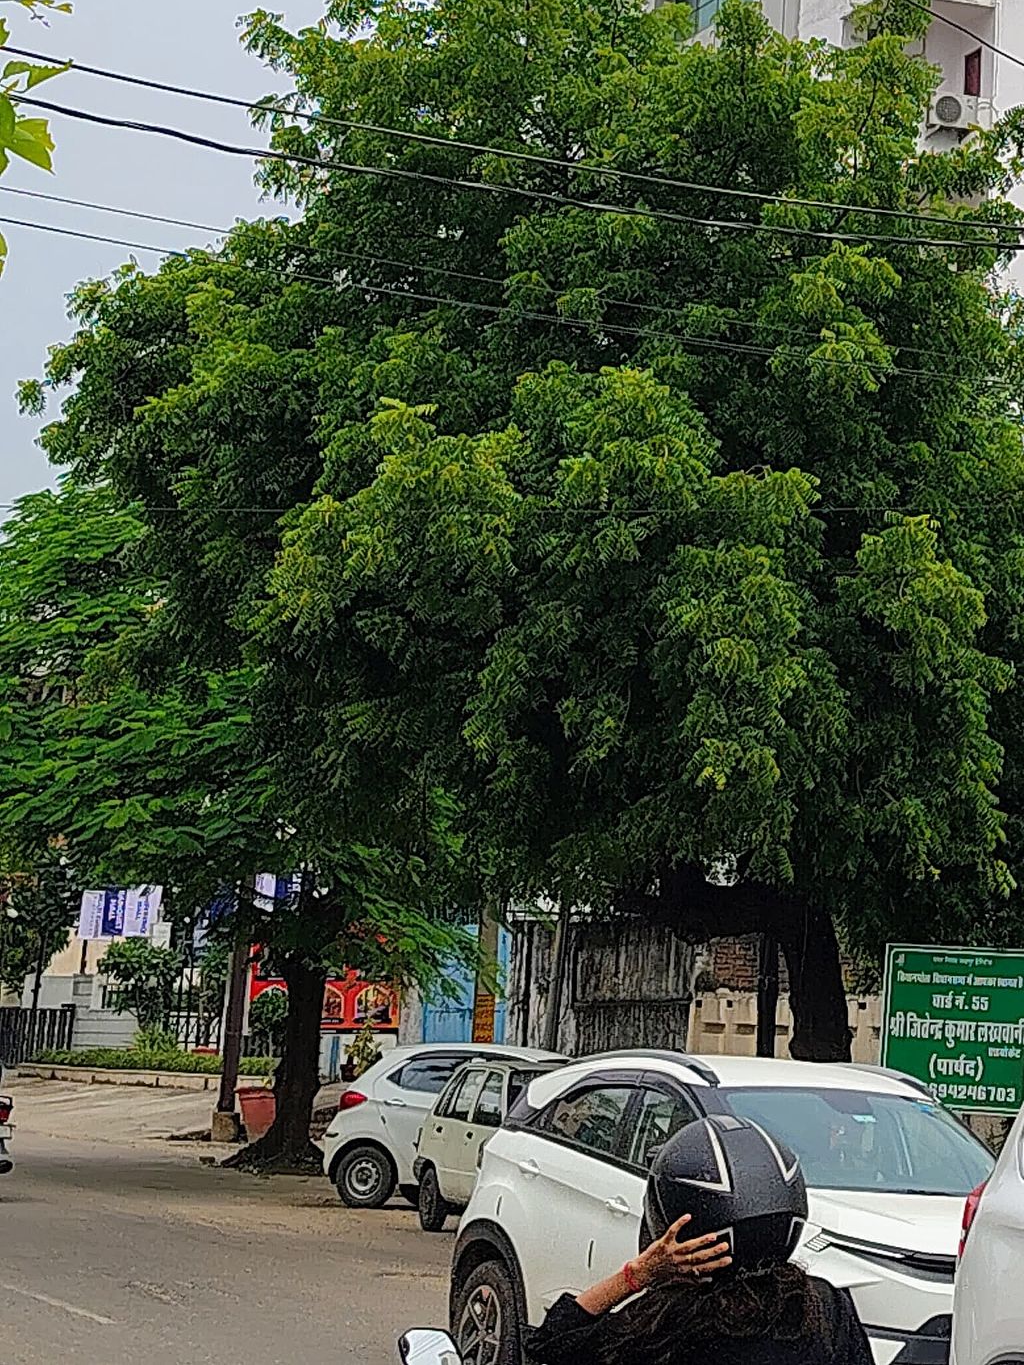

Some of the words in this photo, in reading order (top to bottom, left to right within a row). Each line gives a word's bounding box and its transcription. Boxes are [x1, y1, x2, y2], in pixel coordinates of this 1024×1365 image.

[971, 995, 989, 1011] 55
[889, 1011, 905, 1038] श्री
[945, 1020, 976, 1048] कुमार
